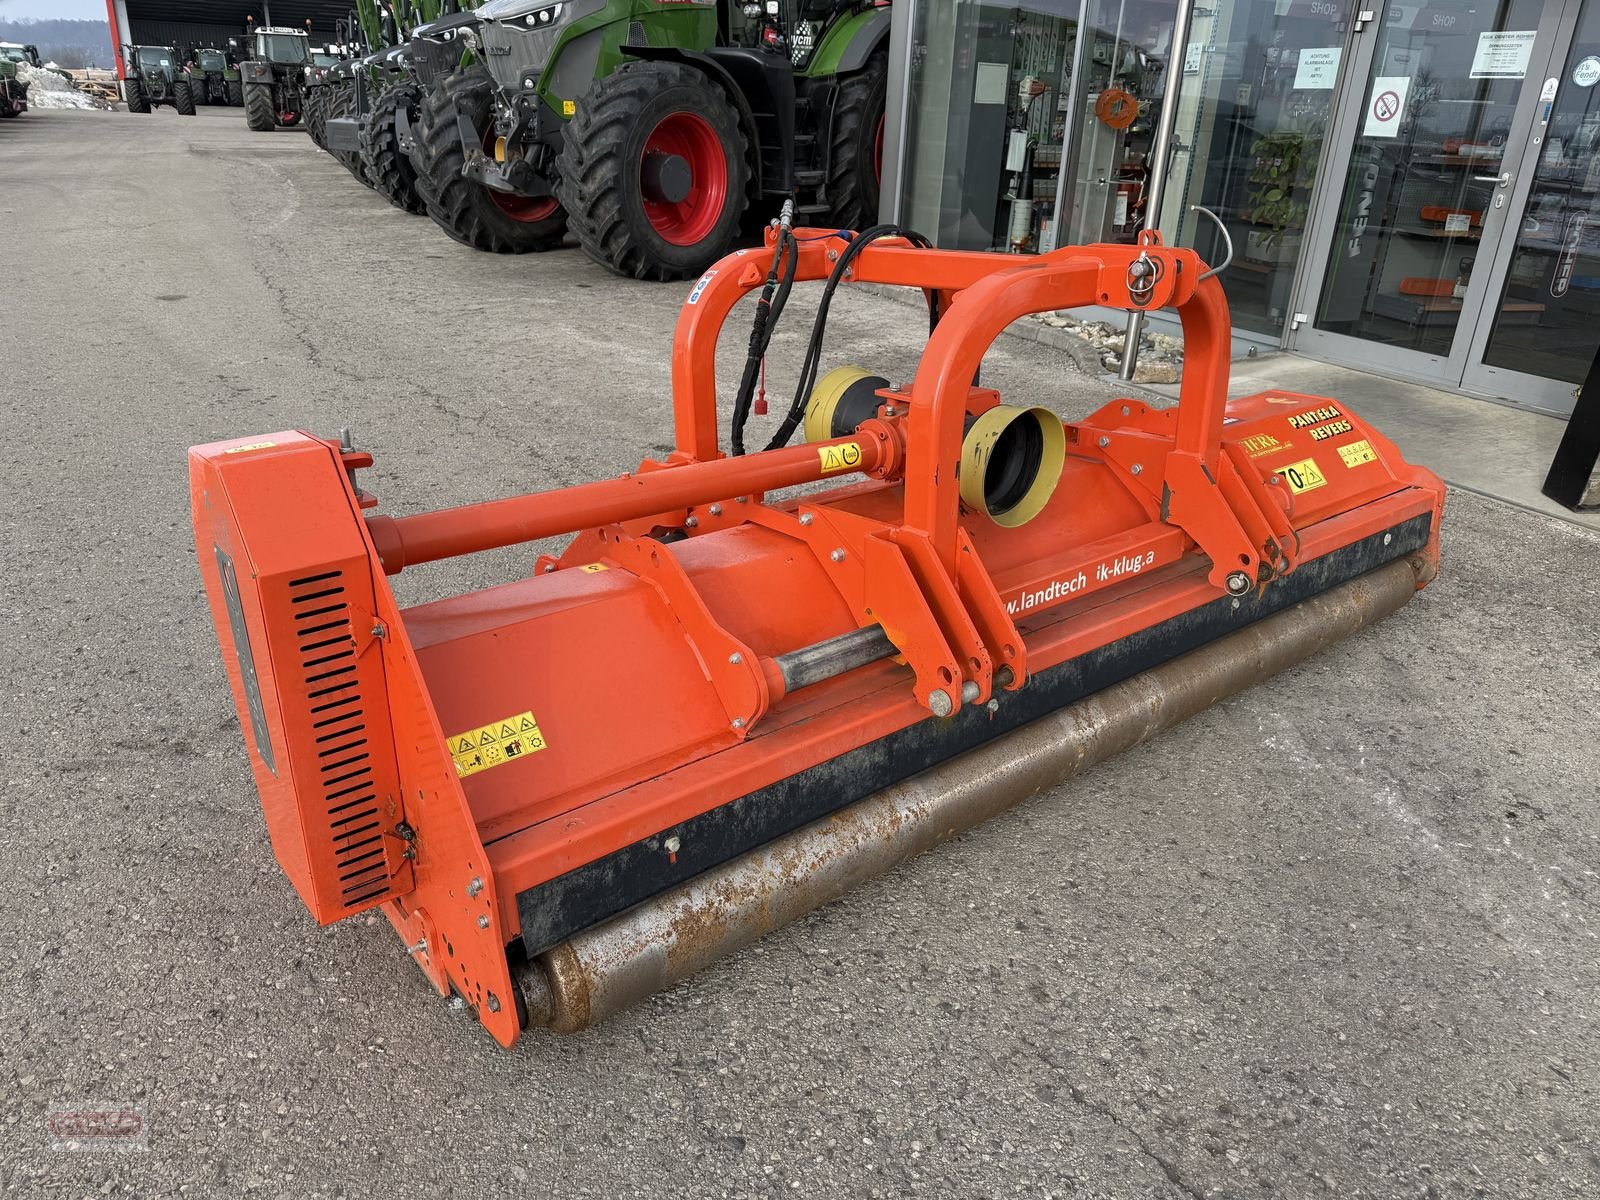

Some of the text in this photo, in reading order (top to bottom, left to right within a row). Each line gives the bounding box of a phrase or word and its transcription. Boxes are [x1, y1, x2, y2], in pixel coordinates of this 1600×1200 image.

[1310, 2, 1337, 15] SHOP
[1432, 14, 1456, 27] SHOP
[1575, 70, 1598, 79] Fendt
[1308, 419, 1353, 441] REVERS
[1096, 550, 1155, 582] ik-klug.a
